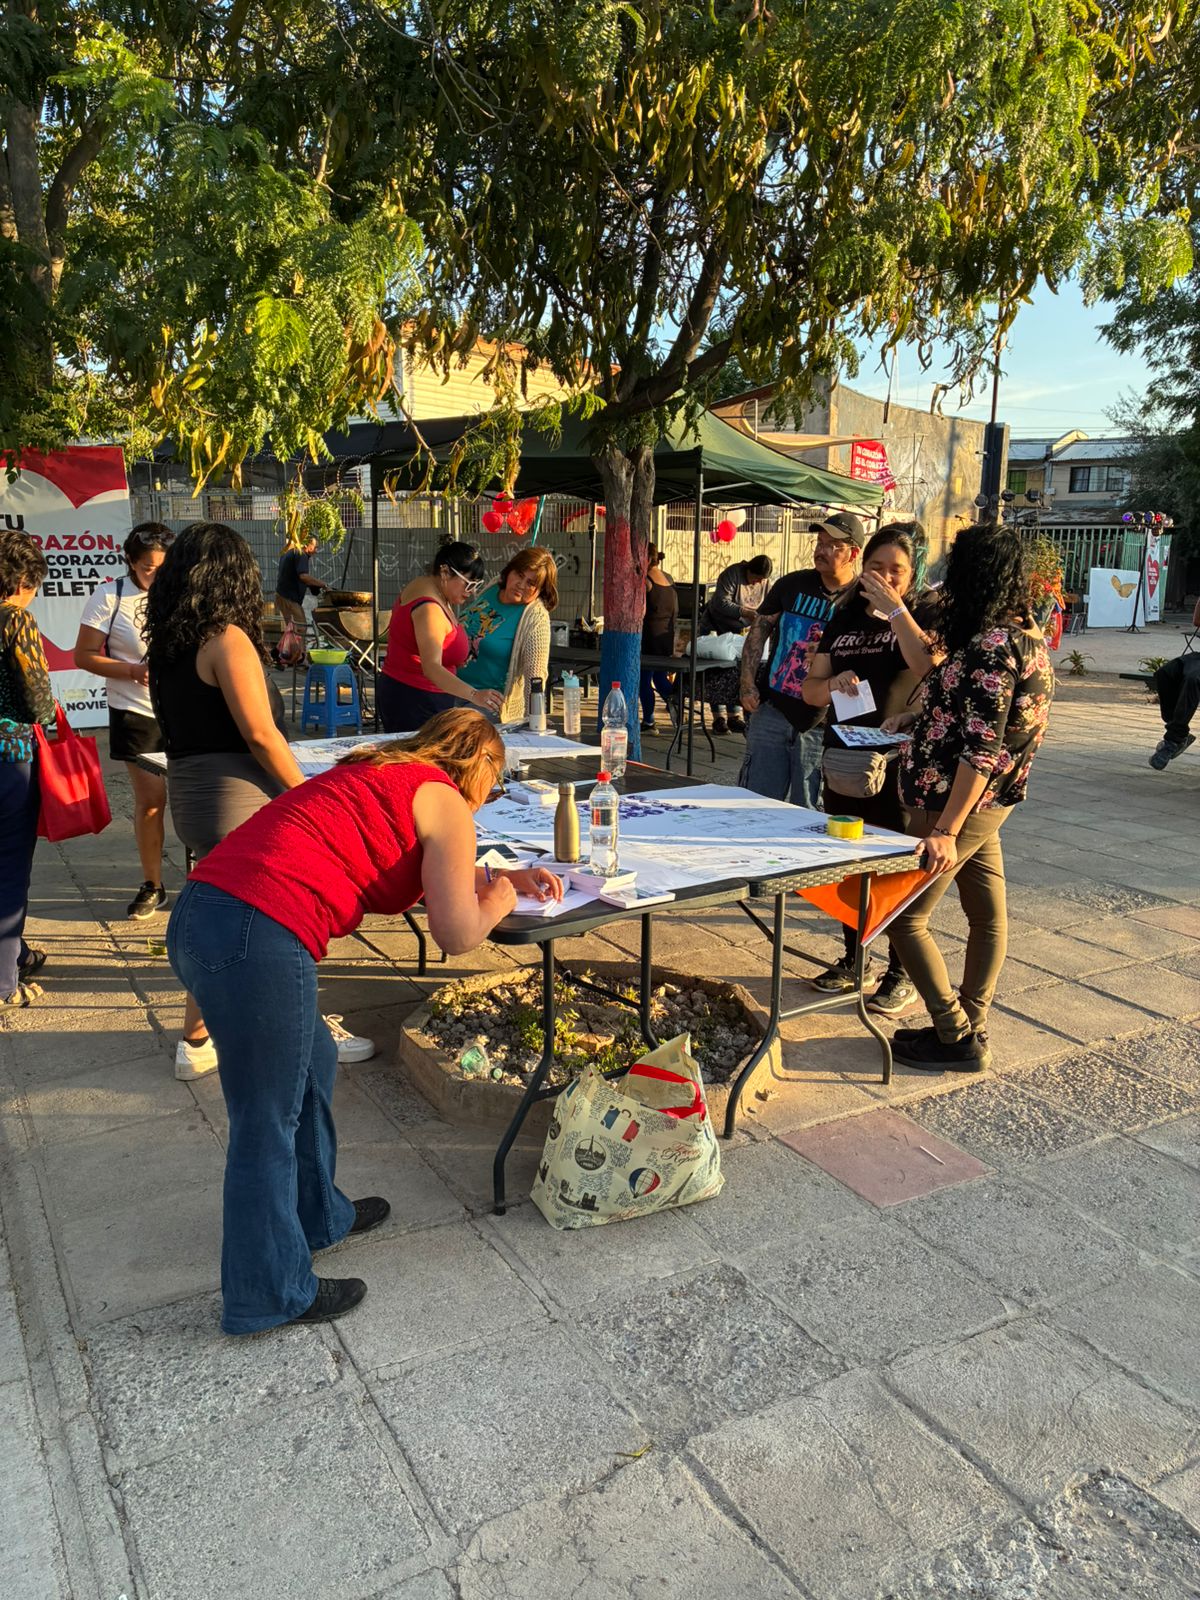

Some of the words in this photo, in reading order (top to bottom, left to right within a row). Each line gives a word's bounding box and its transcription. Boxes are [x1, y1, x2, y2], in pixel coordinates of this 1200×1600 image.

[29, 530, 121, 553] RAZÓN,
[49, 568, 73, 579] DE
[77, 567, 100, 579] LA
[35, 580, 100, 597] ELET
[791, 592, 836, 622] NIRVA
[89, 688, 97, 698] Y
[100, 687, 108, 697] 2
[66, 700, 108, 711] NOVIE
